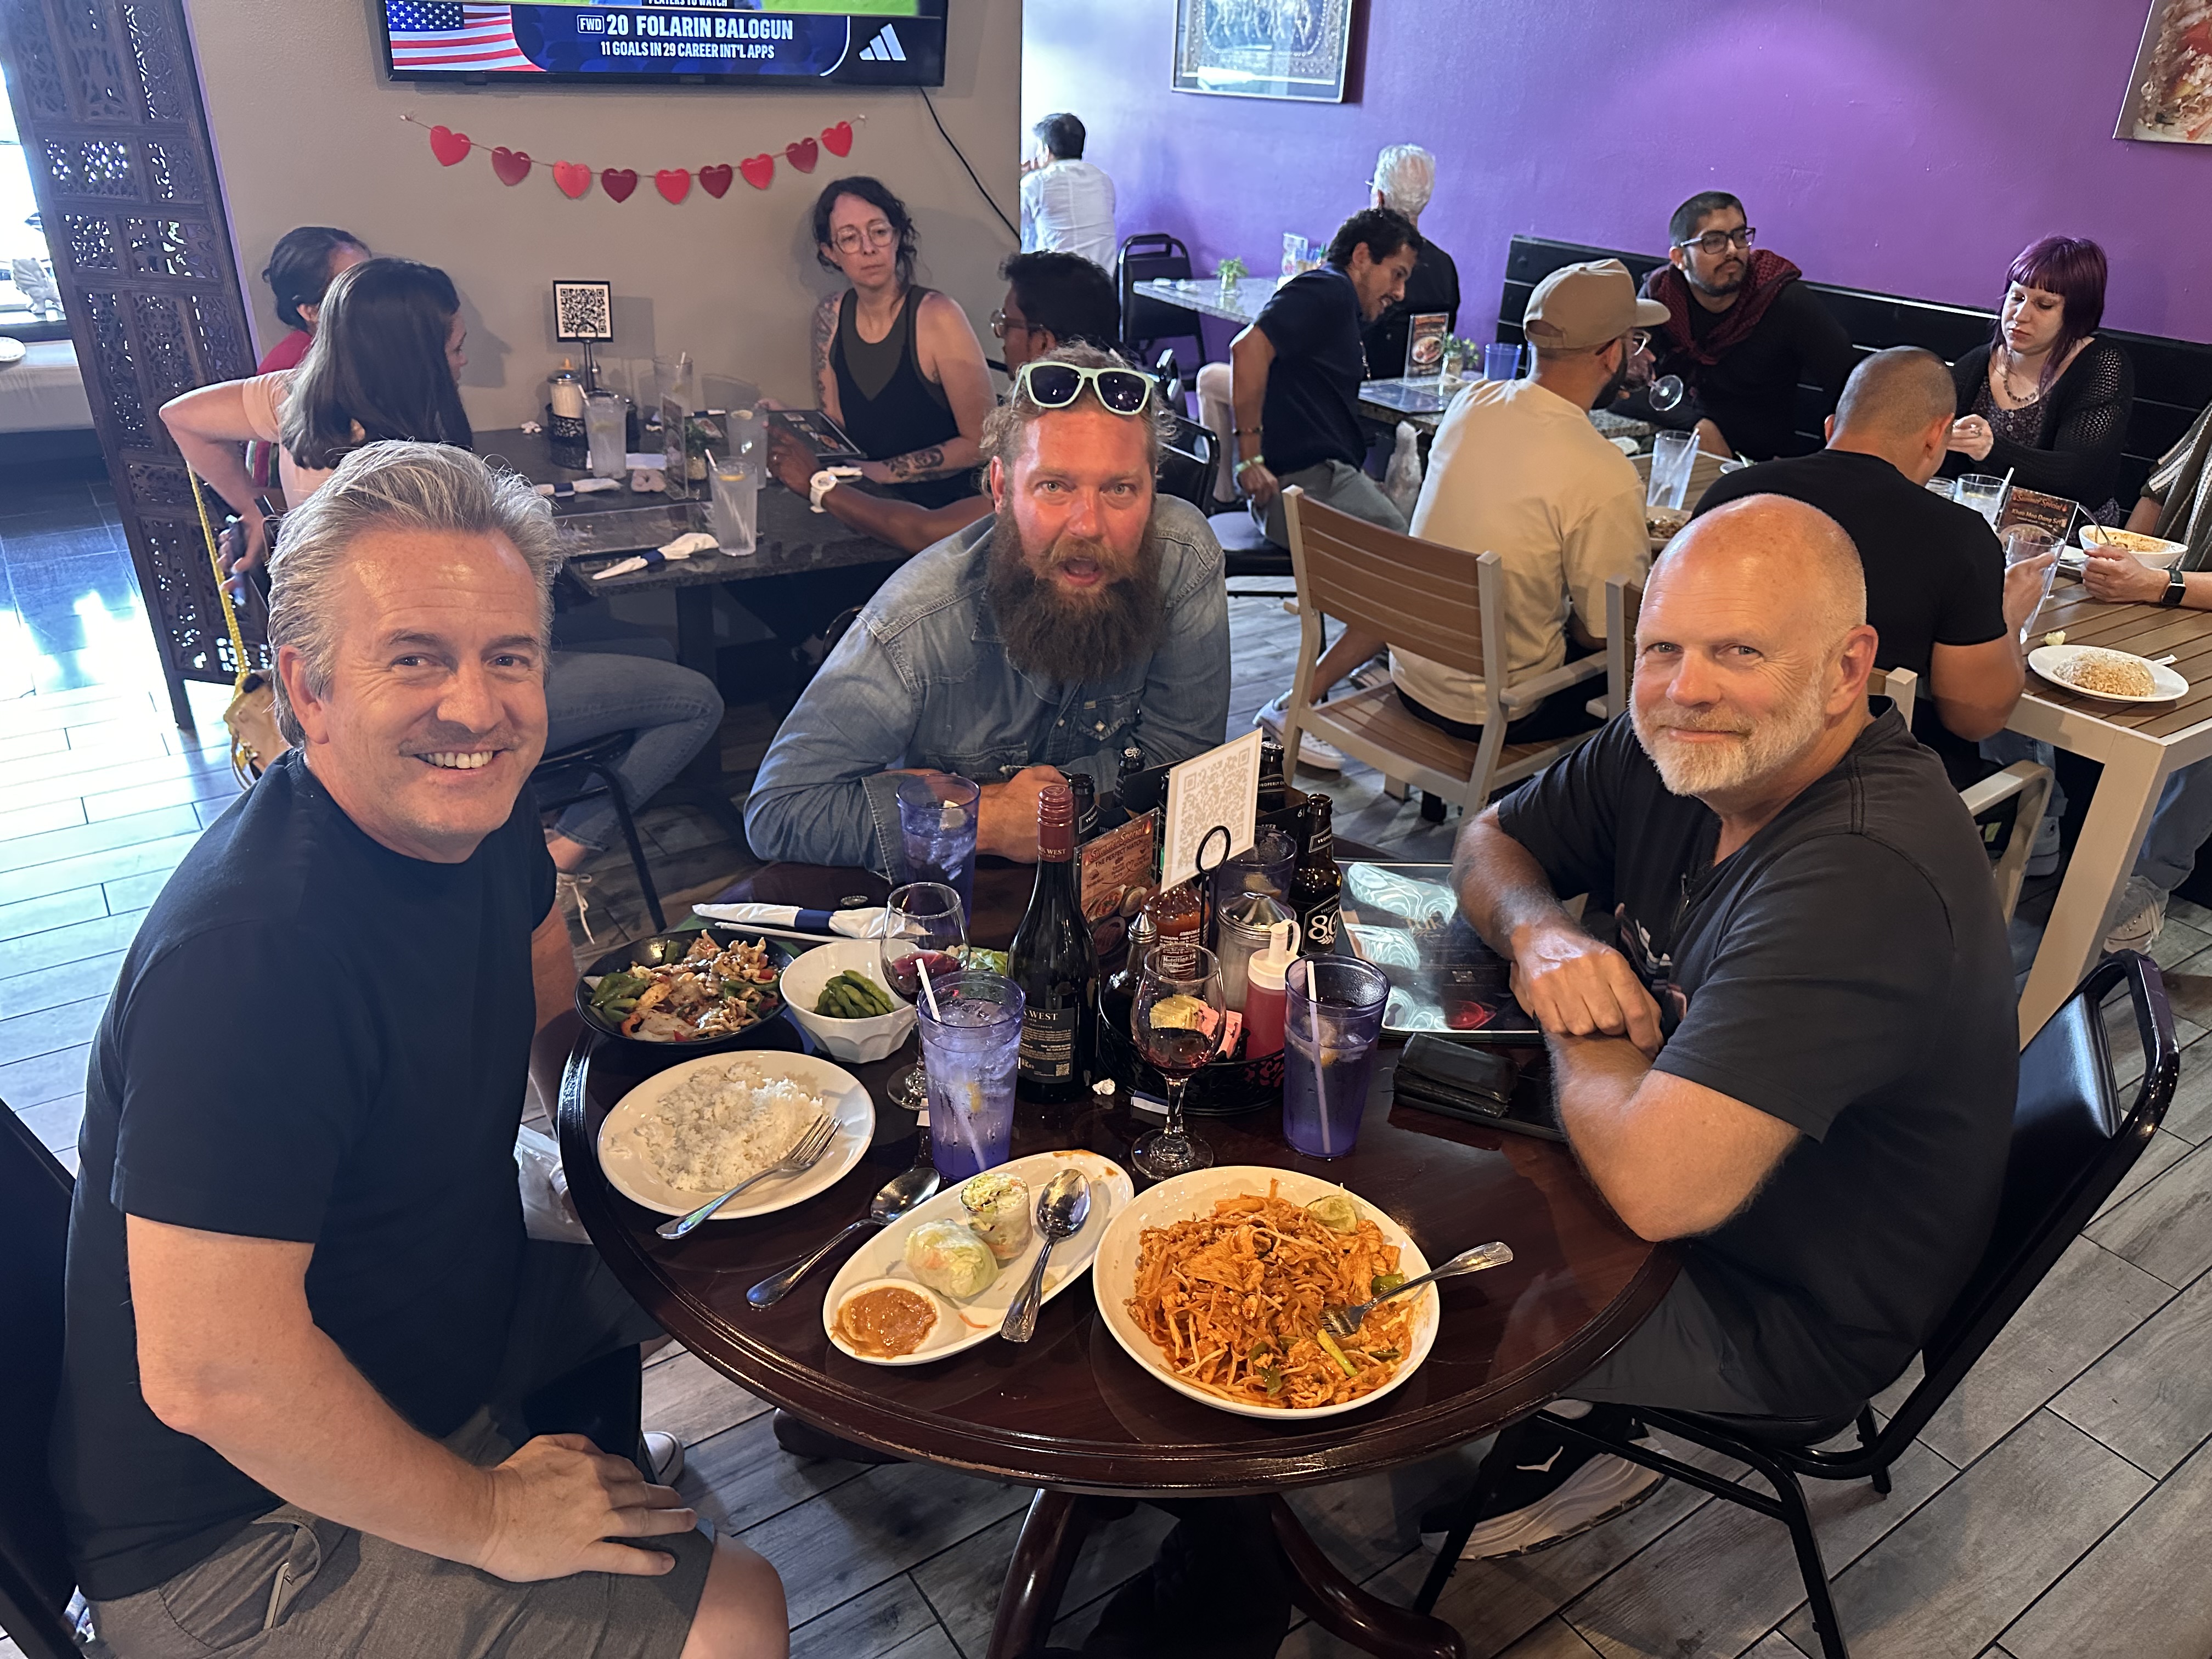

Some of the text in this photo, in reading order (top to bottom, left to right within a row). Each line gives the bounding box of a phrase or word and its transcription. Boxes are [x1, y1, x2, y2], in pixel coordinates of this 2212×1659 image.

[580, 14, 793, 40] FWD 20 FOLARIN BALOGUN
[601, 41, 775, 59] 11 GOALS IN 29 CAREER INT'L APPS
[1091, 824, 1144, 858] Summer Special
[1095, 858, 1105, 867] THE
[1105, 848, 1125, 862] PERFECT
[1127, 839, 1143, 851] MATCH
[1308, 909, 1340, 940] 80
[1029, 1009, 1058, 1020] WEST
